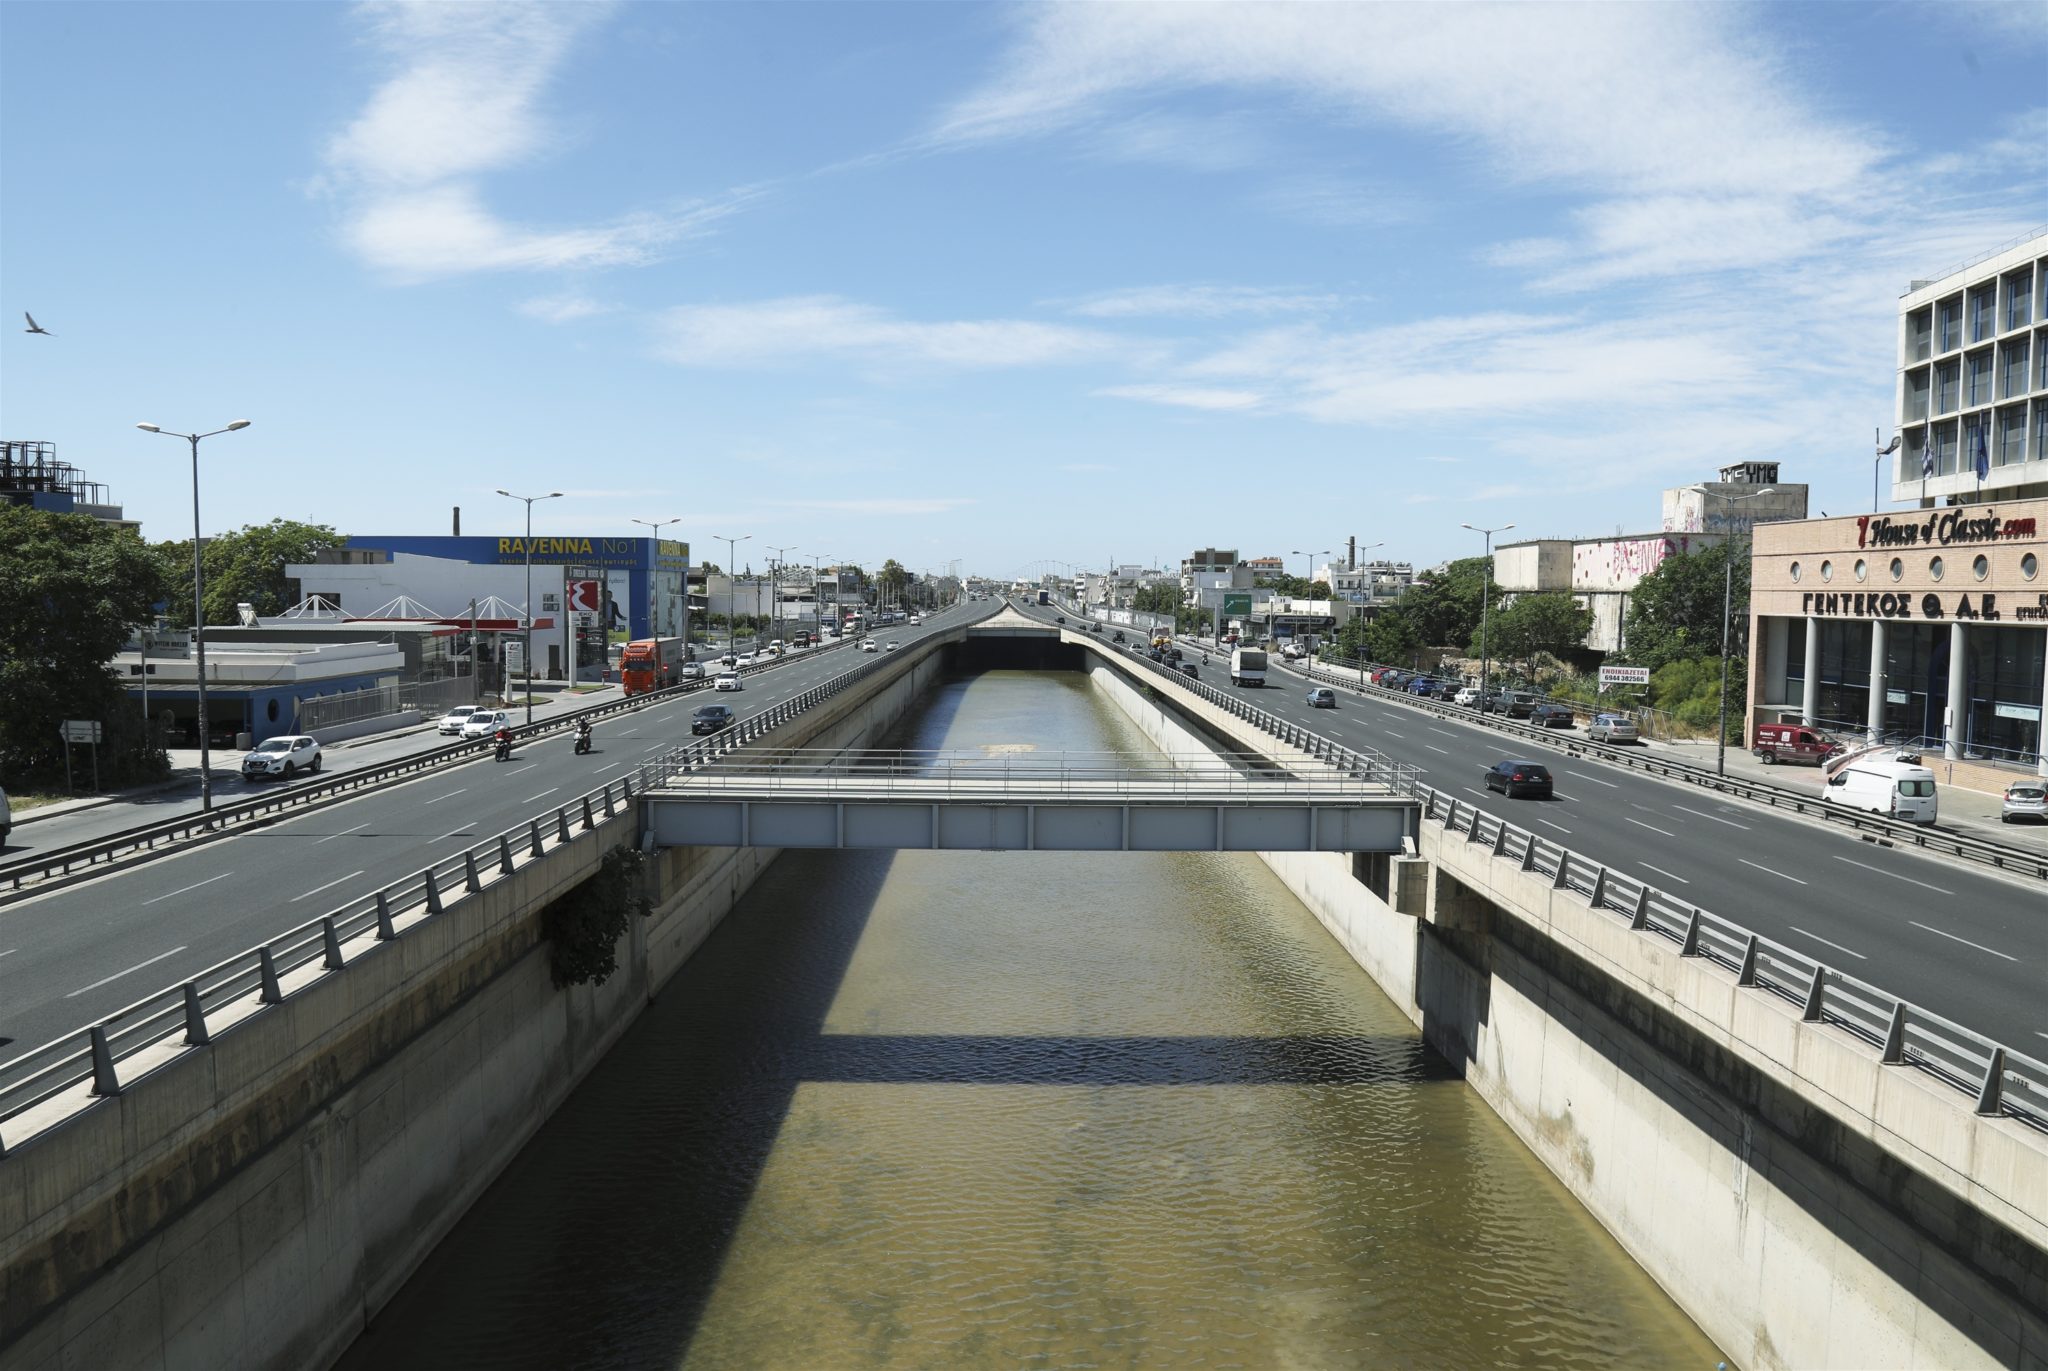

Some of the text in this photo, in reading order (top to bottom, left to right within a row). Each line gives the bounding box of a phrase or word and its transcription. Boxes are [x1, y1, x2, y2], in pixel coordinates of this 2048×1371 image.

[1871, 508, 2036, 546] House of Classic.com
[499, 538, 637, 554] RAVENNA No1
[1803, 593, 1911, 616] ΓΕΝΤΕΚΟΣ
